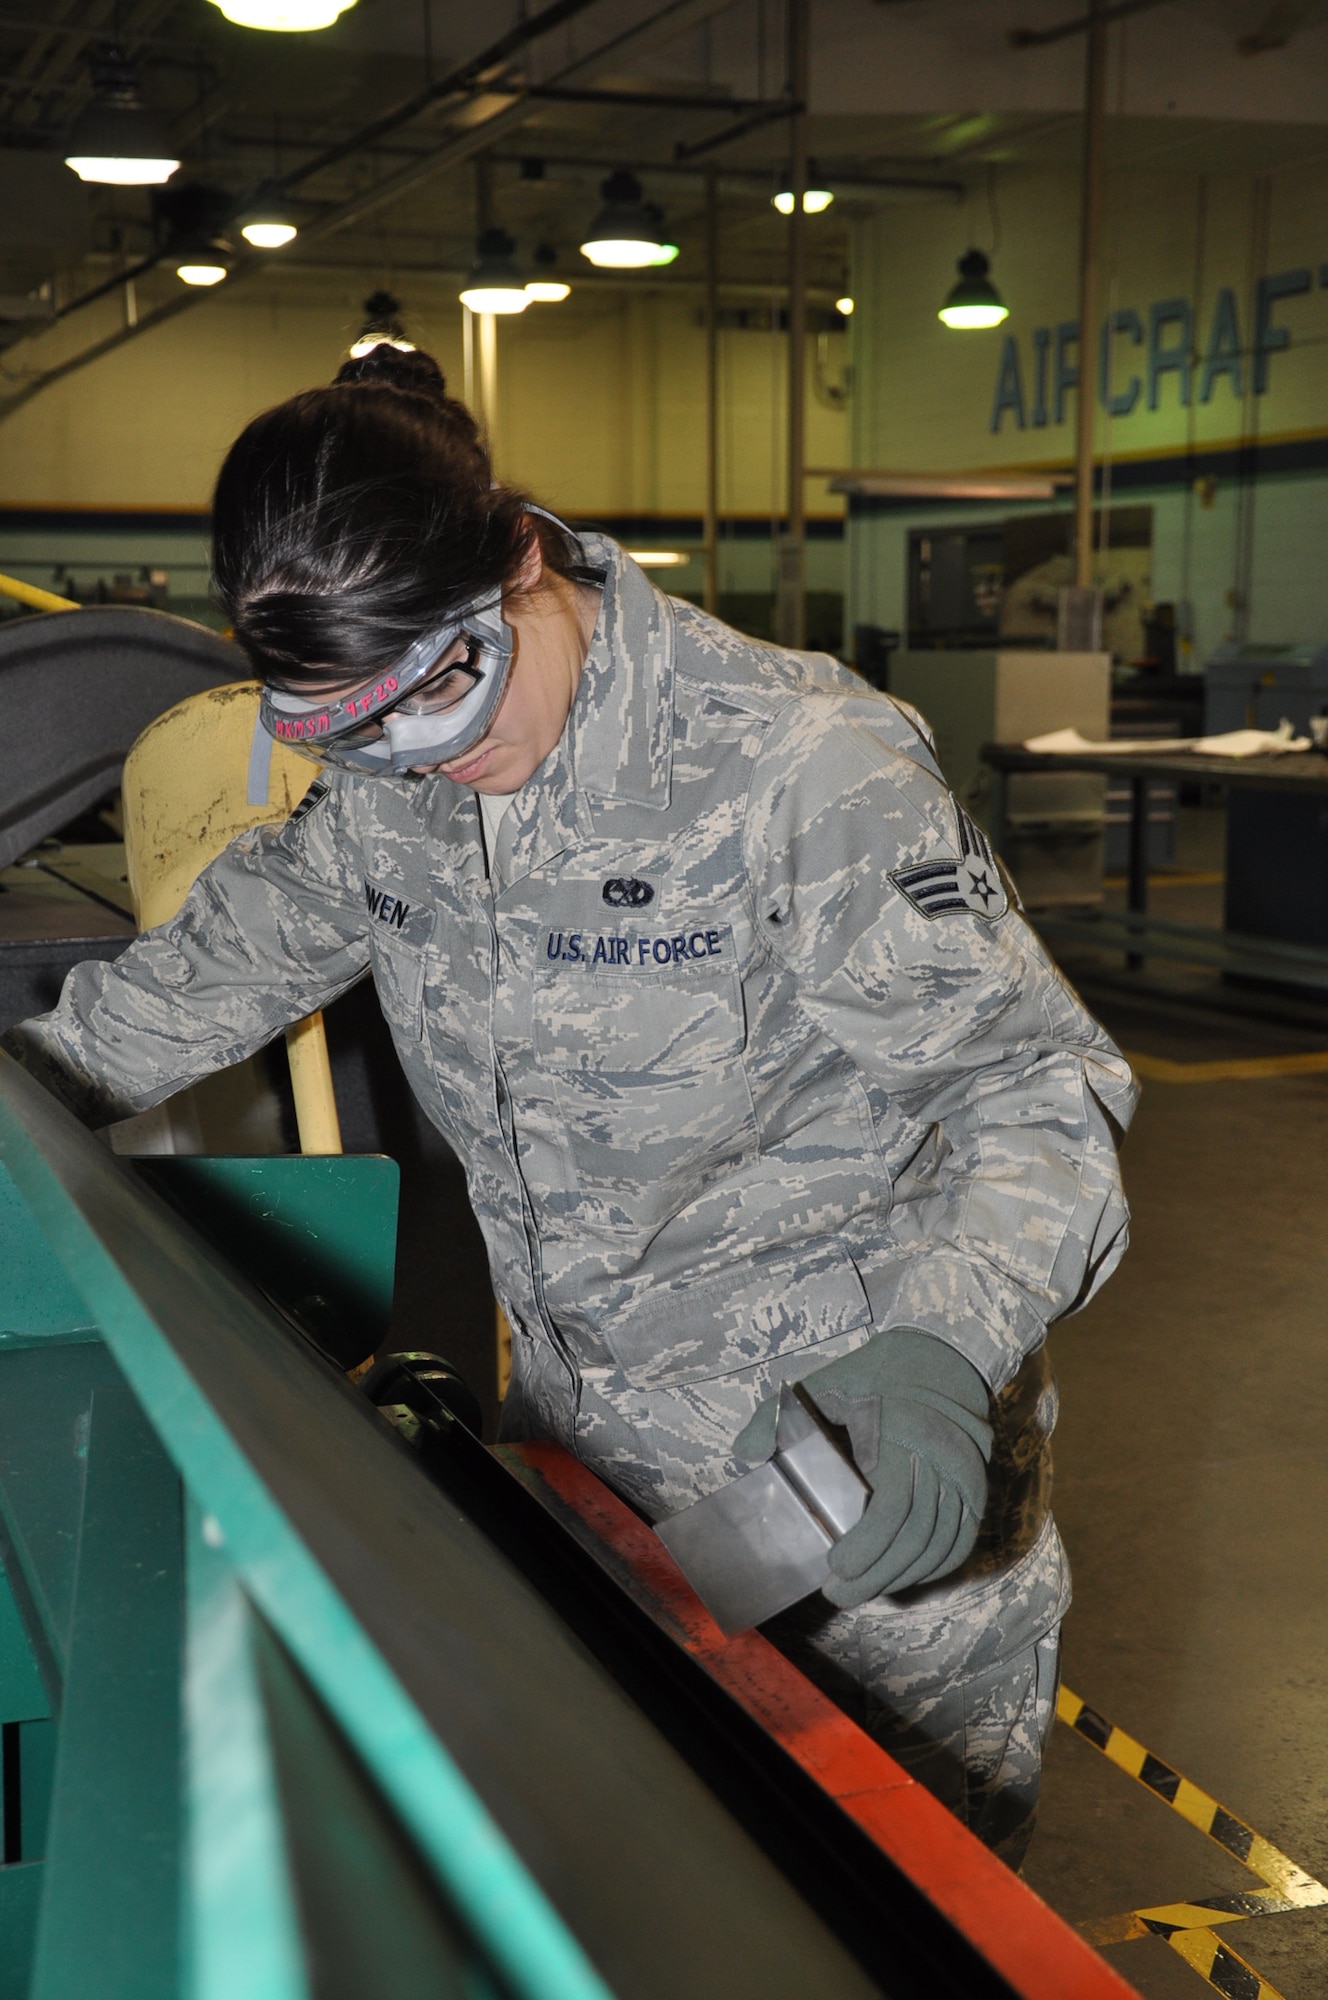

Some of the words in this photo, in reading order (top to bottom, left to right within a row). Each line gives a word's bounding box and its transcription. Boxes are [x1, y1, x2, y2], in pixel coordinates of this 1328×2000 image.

[990, 264, 1328, 434] AIRCRAF
[364, 880, 410, 929] WEN
[547, 932, 586, 962] U.S.
[593, 936, 631, 965] AIR
[638, 930, 722, 965] FORCE
